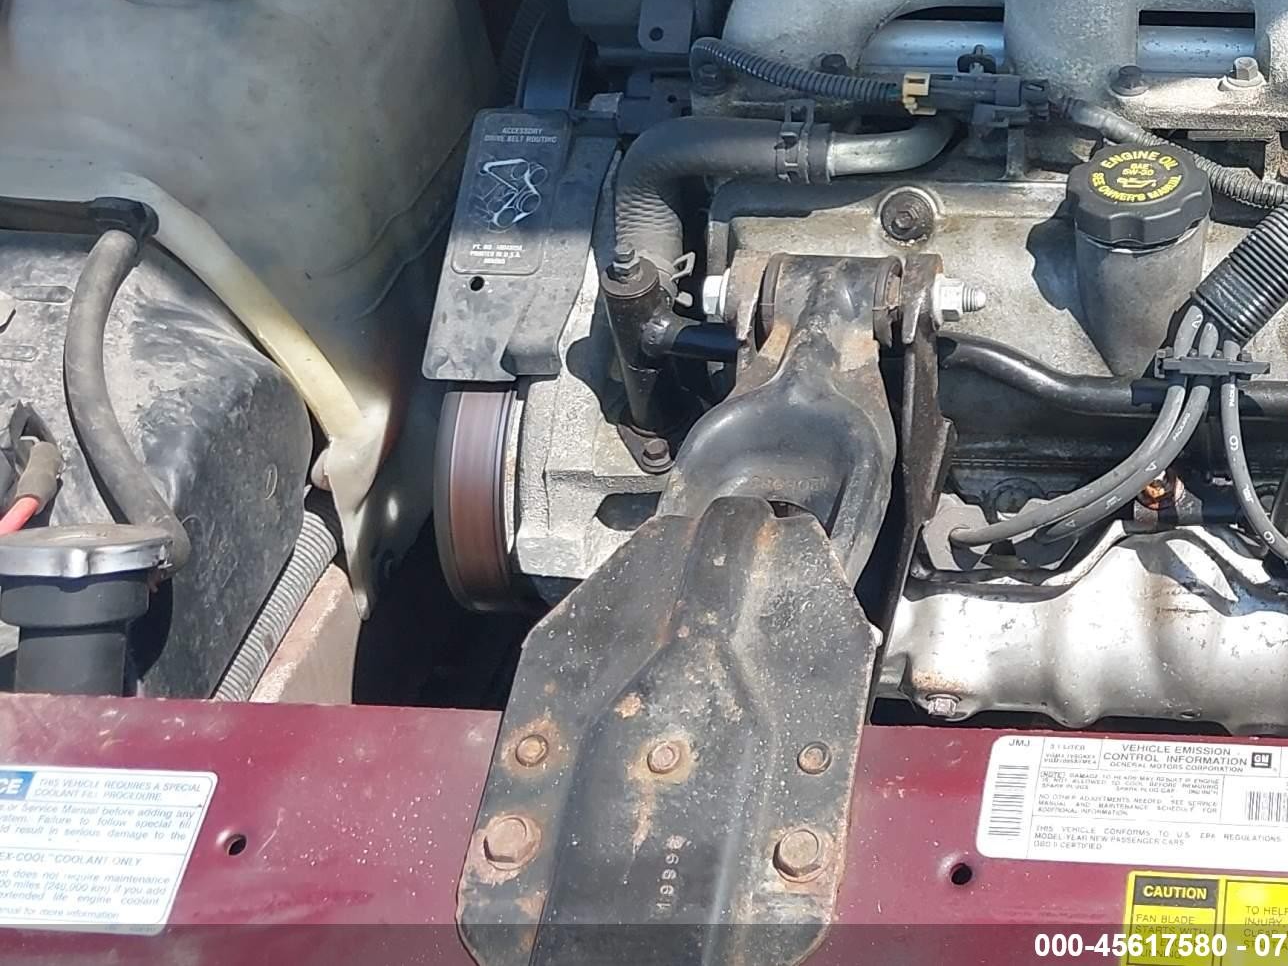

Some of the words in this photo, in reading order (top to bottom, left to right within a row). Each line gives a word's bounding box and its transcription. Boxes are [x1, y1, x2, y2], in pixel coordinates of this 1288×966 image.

[1101, 151, 1160, 168] ENGINE
[1158, 156, 1178, 170] OIL
[1092, 172, 1105, 186] SEE
[1098, 186, 1146, 202] OWNER'S
[1147, 175, 1182, 199] MANUAL
[1009, 739, 1030, 747] JMJ
[1122, 744, 1170, 753] VEHICLE
[1174, 746, 1231, 755] EMISSION
[1104, 752, 1159, 762] CONTROL
[1167, 755, 1247, 766] INFORMATION
[1185, 765, 1243, 773] CORPORATION
[40, 778, 59, 788] THIS
[63, 779, 98, 789] VEHICLE
[104, 781, 151, 790] REQUIRES
[152, 782, 160, 791] A
[163, 782, 201, 792] SPECIAL
[35, 788, 80, 798] COOLANT
[23, 803, 59, 814] Service
[62, 805, 98, 815] Manual
[102, 806, 134, 817] before
[138, 808, 172, 820] adding
[176, 811, 195, 820] any
[38, 815, 72, 824] Failure
[80, 817, 89, 826] to
[97, 818, 127, 827] follow
[135, 820, 171, 829] special
[179, 820, 191, 829] fill
[15, 826, 44, 835] result
[49, 827, 58, 835] in
[64, 828, 101, 837] serious
[107, 829, 149, 840] damage
[154, 831, 164, 840] to
[170, 831, 186, 841] the
[1062, 826, 1096, 834] VEHICLE
[1104, 827, 1150, 836] CONFORMS
[1224, 834, 1282, 842] REGULATIONS
[1060, 842, 1102, 850] CERTIFIED
[1110, 836, 1160, 845] PASSENGER
[1162, 838, 1184, 846] CARS
[55, 854, 110, 865] COOLANT
[112, 856, 142, 866] ONLY
[14, 870, 38, 880] does
[42, 871, 59, 881] not
[64, 872, 99, 884] require
[104, 873, 170, 884] maintenance
[14, 879, 40, 890] miles
[124, 887, 142, 896] you
[146, 886, 166, 895] add
[1143, 885, 1207, 900] CAUTION
[53, 893, 68, 902] life
[77, 895, 112, 905] engine
[120, 895, 160, 905] coolant
[66, 910, 119, 919] information
[1245, 905, 1260, 915] TO
[1136, 914, 1157, 923] FAN
[1161, 914, 1195, 925] BLADE
